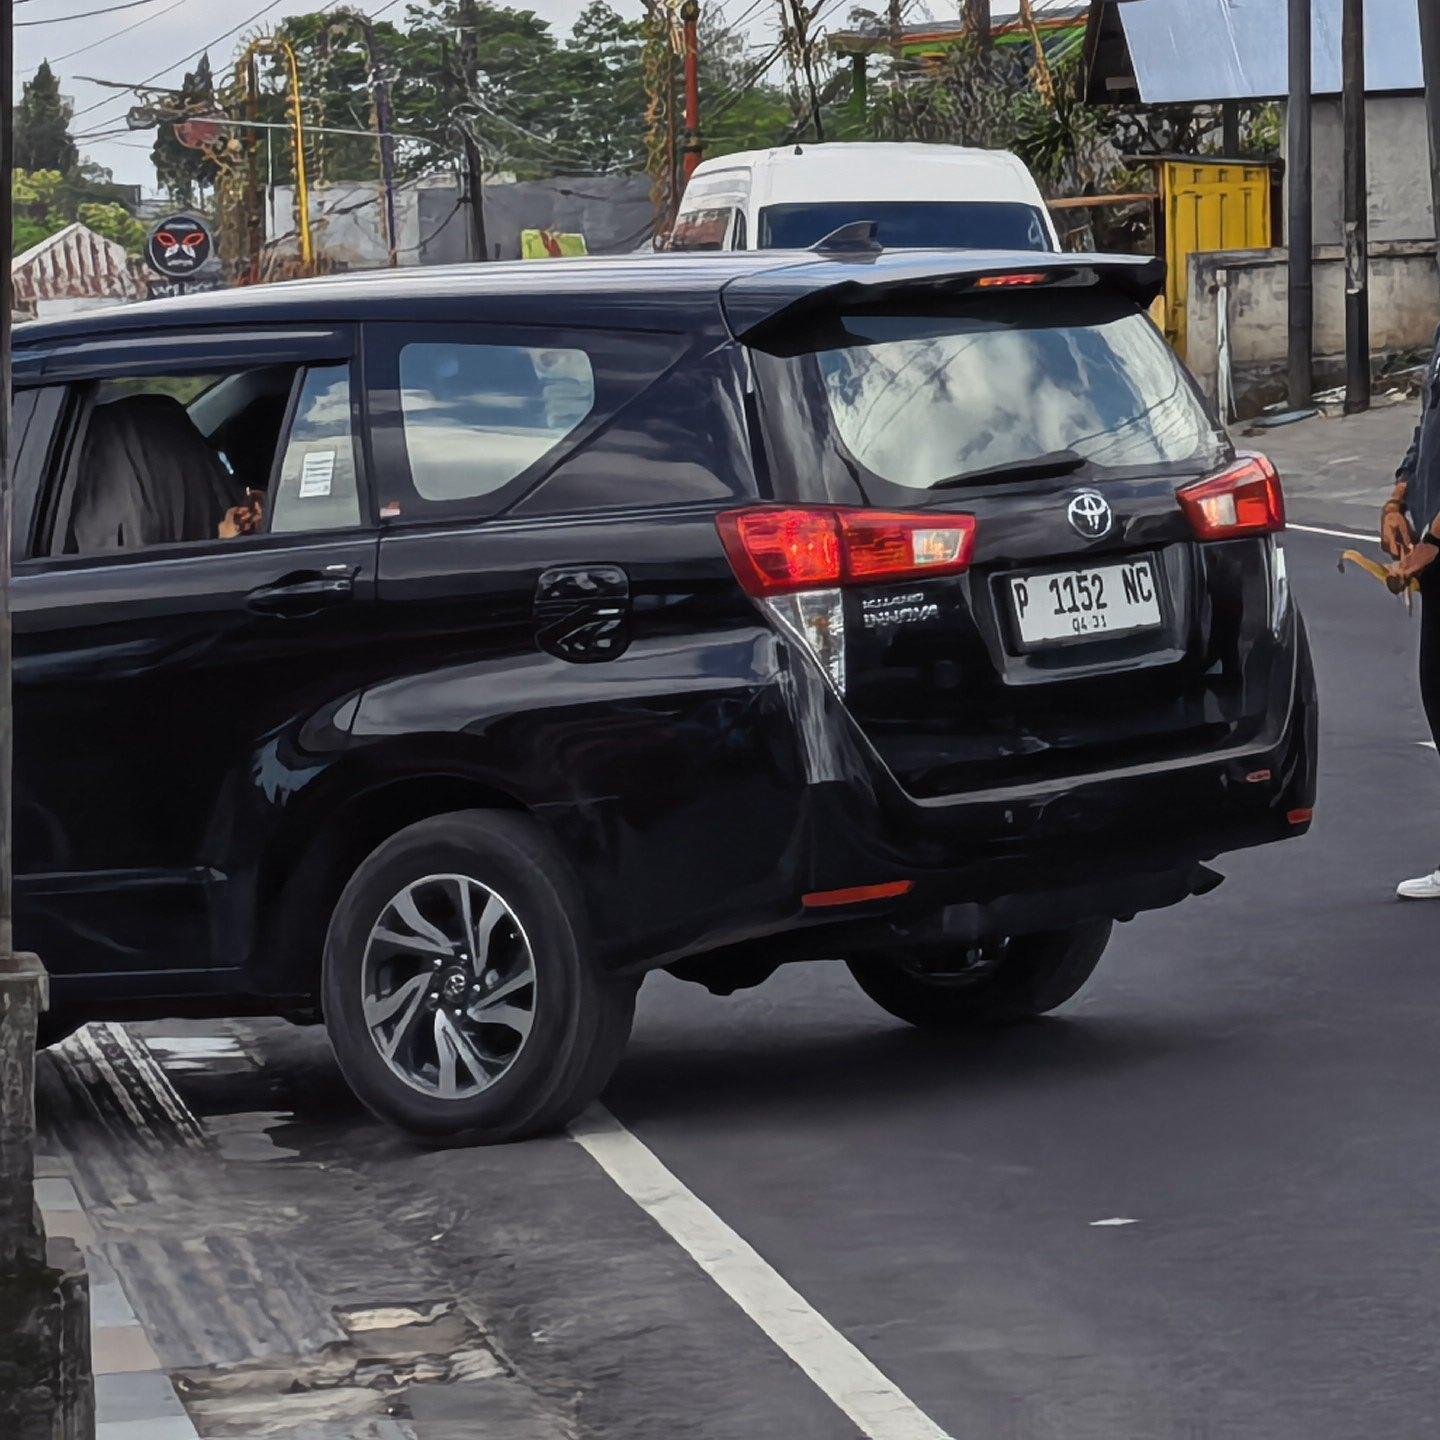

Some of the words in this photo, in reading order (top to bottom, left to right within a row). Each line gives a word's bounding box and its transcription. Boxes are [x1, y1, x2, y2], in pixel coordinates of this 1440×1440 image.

[1013, 582, 1029, 619] P
[1049, 573, 1108, 616] 1152
[1122, 565, 1153, 606] NC
